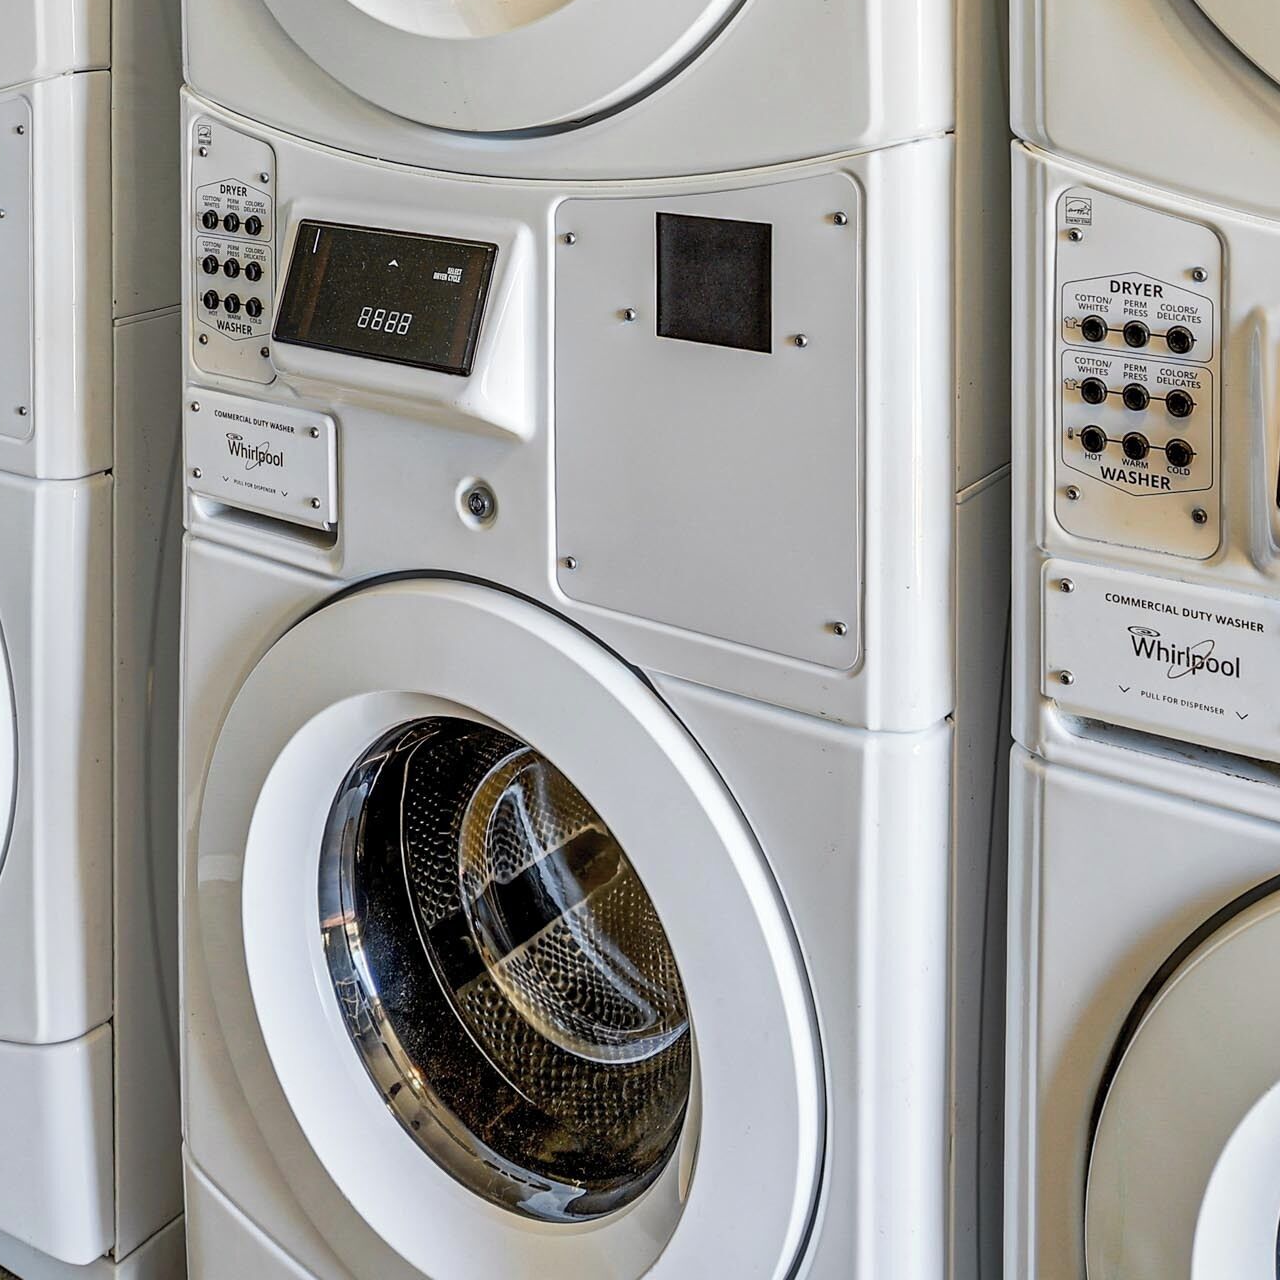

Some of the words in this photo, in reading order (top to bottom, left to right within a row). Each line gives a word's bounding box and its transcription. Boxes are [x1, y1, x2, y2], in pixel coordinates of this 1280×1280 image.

[221, 184, 247, 197] DRYER
[1110, 280, 1164, 299] DRYER
[1075, 294, 1112, 305] COTTON/
[1124, 300, 1148, 309] PERM
[1078, 303, 1109, 313] WHITES
[1124, 308, 1148, 318] PRESS
[1160, 304, 1198, 314] COLORS/
[358, 307, 412, 335] 8888
[1157, 312, 1202, 324] DELICATES
[217, 320, 253, 336] WASHER
[1075, 357, 1112, 368] COTTON/
[1078, 366, 1109, 376] WHITES
[1124, 364, 1147, 373] PERM
[1160, 369, 1198, 379] COLORS/
[1123, 372, 1148, 382] PRESS
[1157, 377, 1201, 389] DELICATES
[215, 410, 252, 424] COMMERCIAL
[253, 419, 268, 428] DUTY
[270, 422, 295, 434] WASHER
[228, 440, 283, 467] Whirlpool
[1085, 453, 1102, 461] HOT
[1122, 459, 1149, 469] WARM
[1167, 466, 1190, 476] COLD
[1101, 466, 1172, 491] WASHER
[1105, 593, 1179, 616] COMMERCIAL
[1183, 608, 1213, 622] DUTY
[1216, 615, 1264, 633] WASHER
[1131, 635, 1240, 678] Whirlpool
[1141, 691, 1160, 701] PULL
[1163, 696, 1178, 705] FOR
[1181, 700, 1225, 716] DISPENSER
